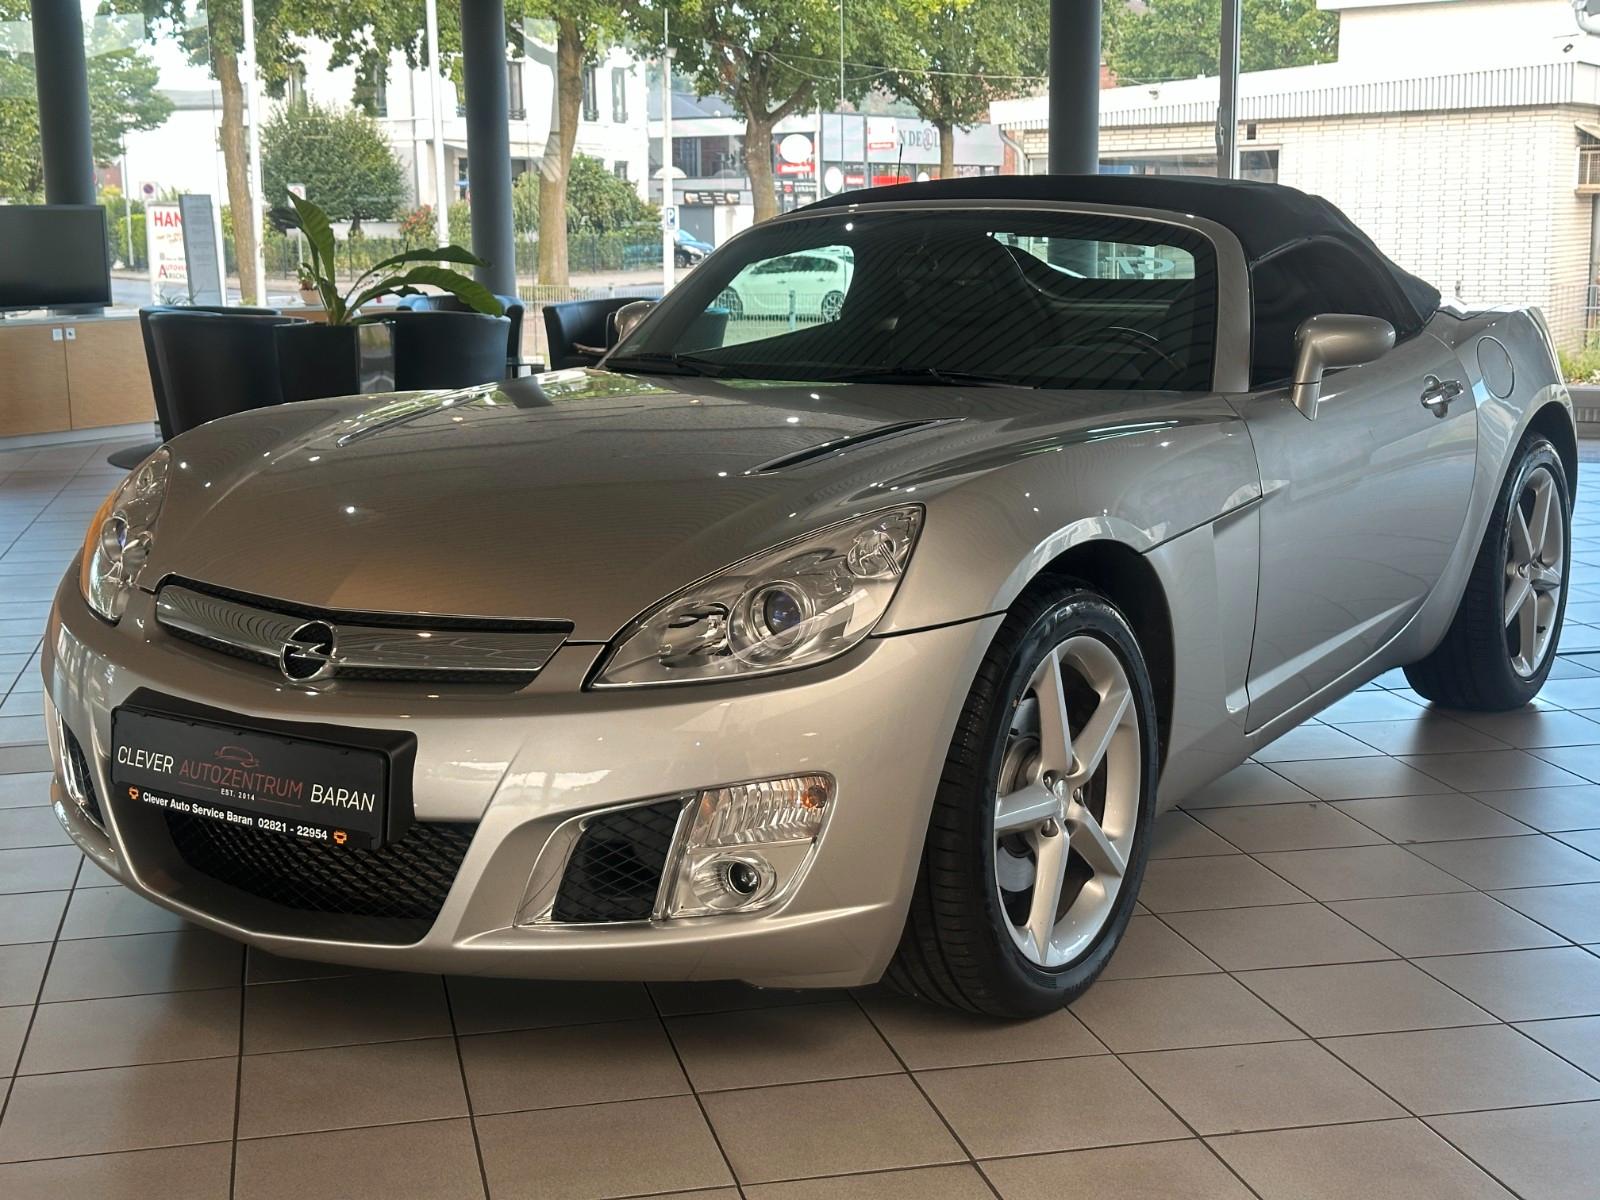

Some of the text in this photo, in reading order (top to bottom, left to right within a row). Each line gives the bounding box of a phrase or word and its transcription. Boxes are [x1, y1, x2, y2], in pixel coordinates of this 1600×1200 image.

[117, 745, 376, 813] CLEVER AUTOZENTRUM BARAN
[220, 787, 256, 801] EST. 2014
[142, 791, 169, 807] Clever
[169, 798, 191, 812] Auto
[192, 803, 225, 820] Service
[226, 810, 254, 826] Baran
[257, 817, 287, 833] 02821
[296, 825, 328, 840] 22954
